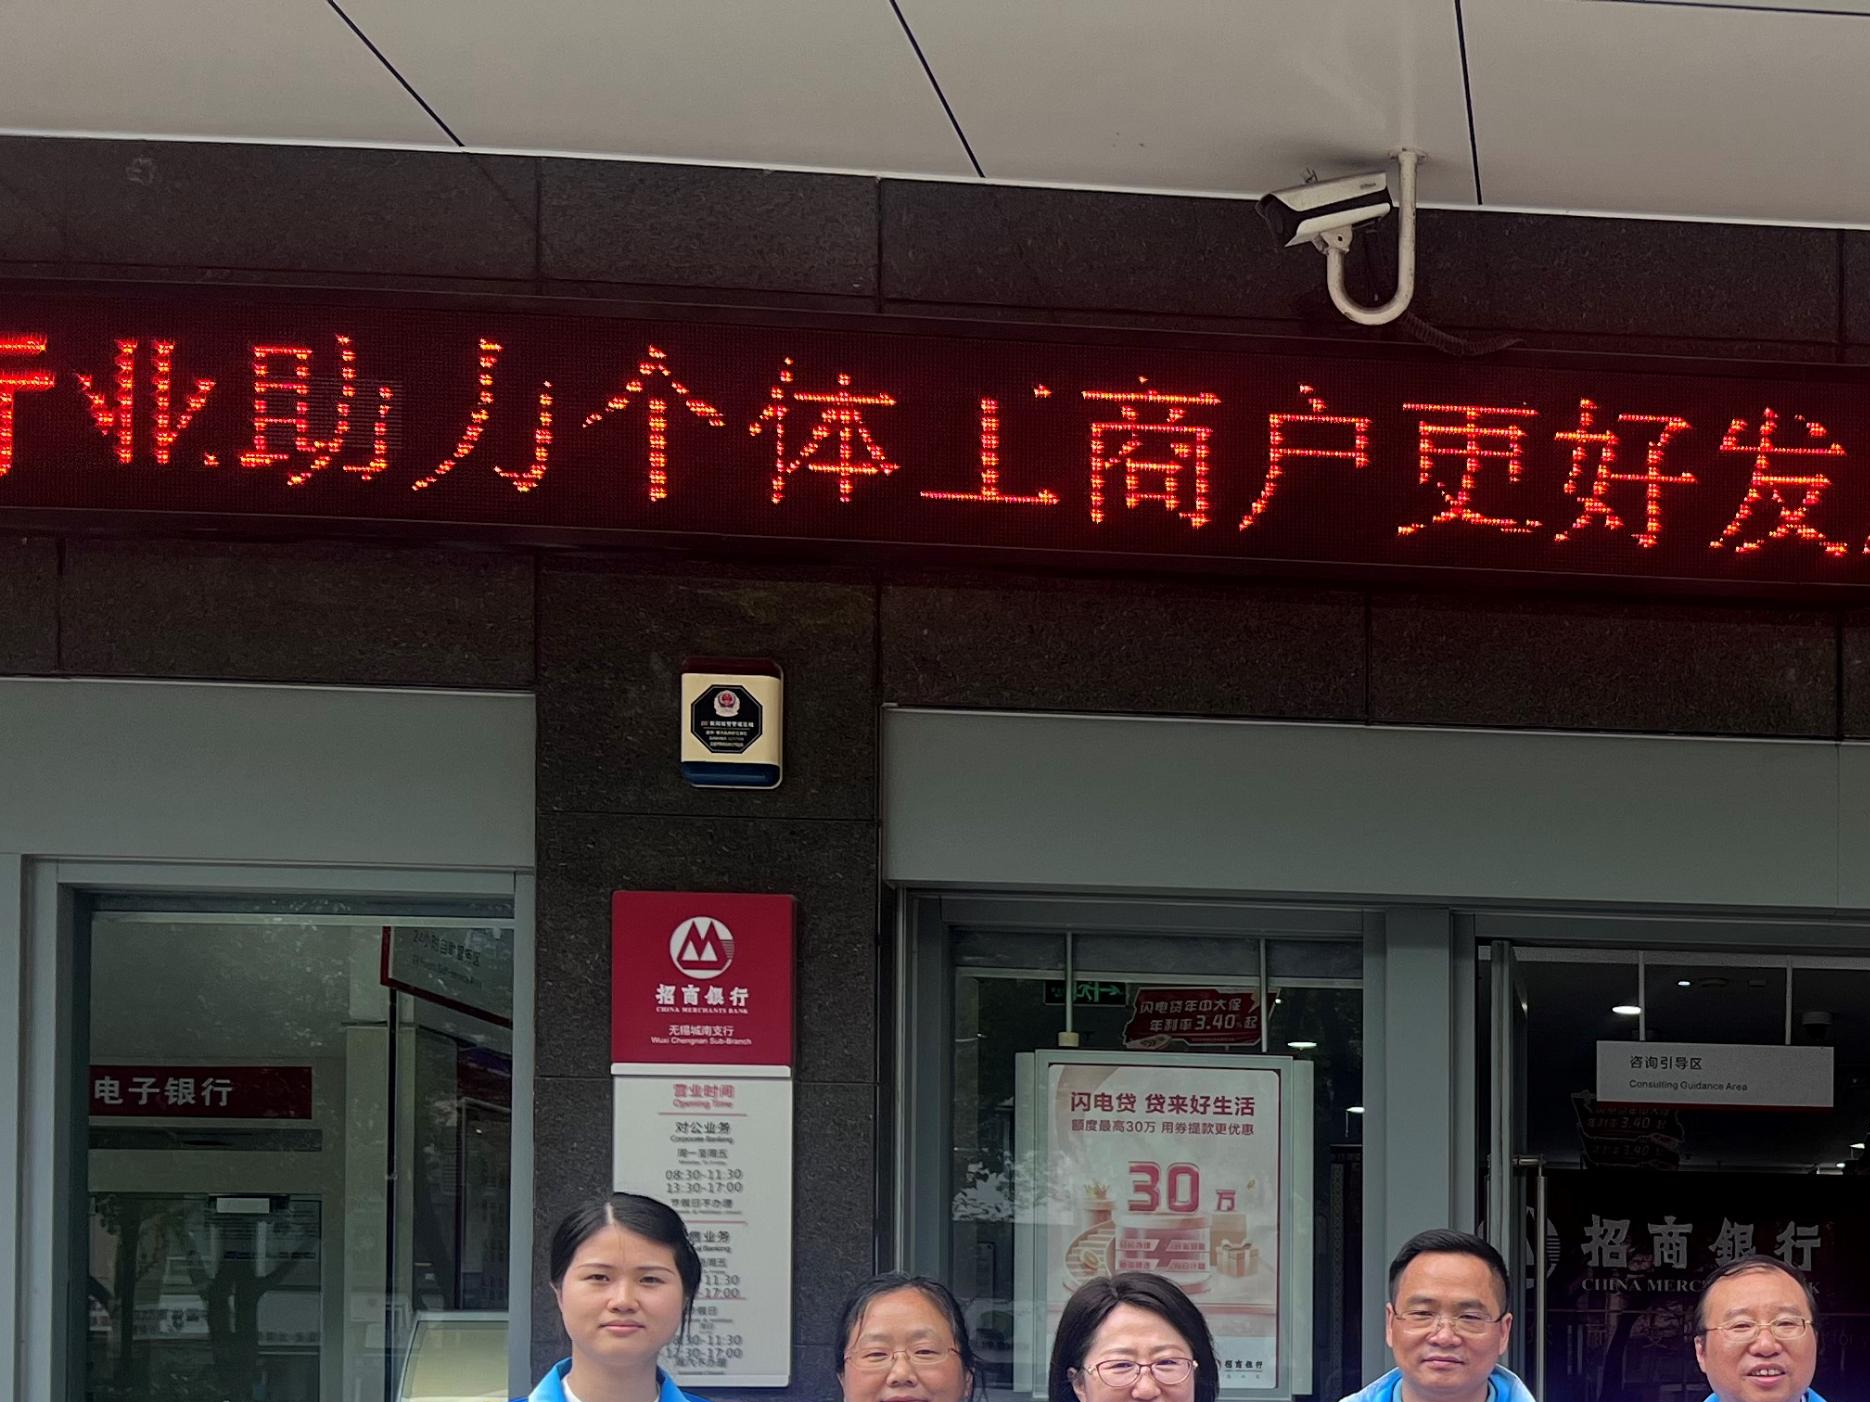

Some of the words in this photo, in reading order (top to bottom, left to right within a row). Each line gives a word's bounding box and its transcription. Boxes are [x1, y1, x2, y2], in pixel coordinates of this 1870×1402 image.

[669, 1024, 734, 1036] 无锡城南支行
[1629, 1055, 1703, 1071] 咨询引导区
[94, 1076, 233, 1107] 电子银行
[673, 1083, 734, 1098] 营业时间
[1629, 1079, 1677, 1091] Consulting
[1680, 1080, 1722, 1091] Guidance
[1724, 1081, 1748, 1091] Area
[1070, 1091, 1137, 1112] 闪电贷
[1145, 1095, 1256, 1117] 贷来好生活
[675, 1121, 730, 1134] 对公业务
[1071, 1119, 1156, 1133] 额度最高30万
[1161, 1121, 1255, 1136] 用券提款更优惠
[1581, 1278, 1644, 1293] CHINA
